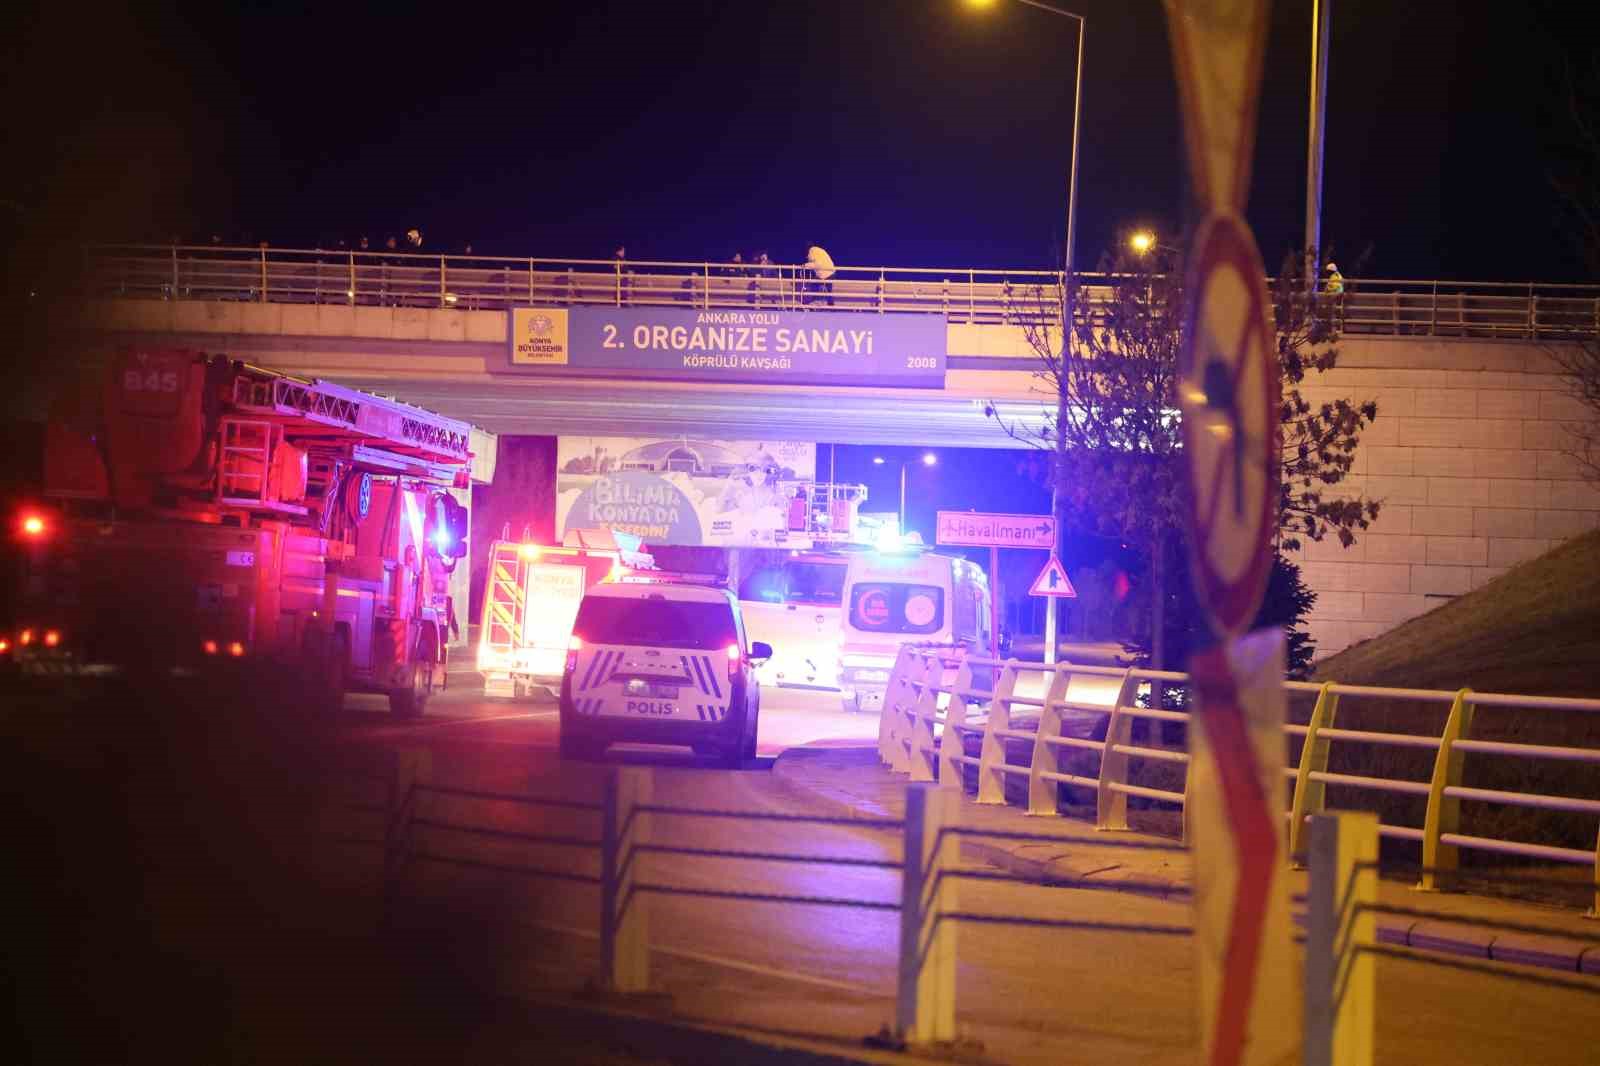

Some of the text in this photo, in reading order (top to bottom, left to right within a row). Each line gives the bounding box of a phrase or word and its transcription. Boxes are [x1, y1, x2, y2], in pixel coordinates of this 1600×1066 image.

[697, 312, 780, 326] ANKARA YOLU
[602, 323, 625, 349] 2.
[682, 353, 738, 369] KÖPRÜLÜ
[907, 357, 937, 369] 2008
